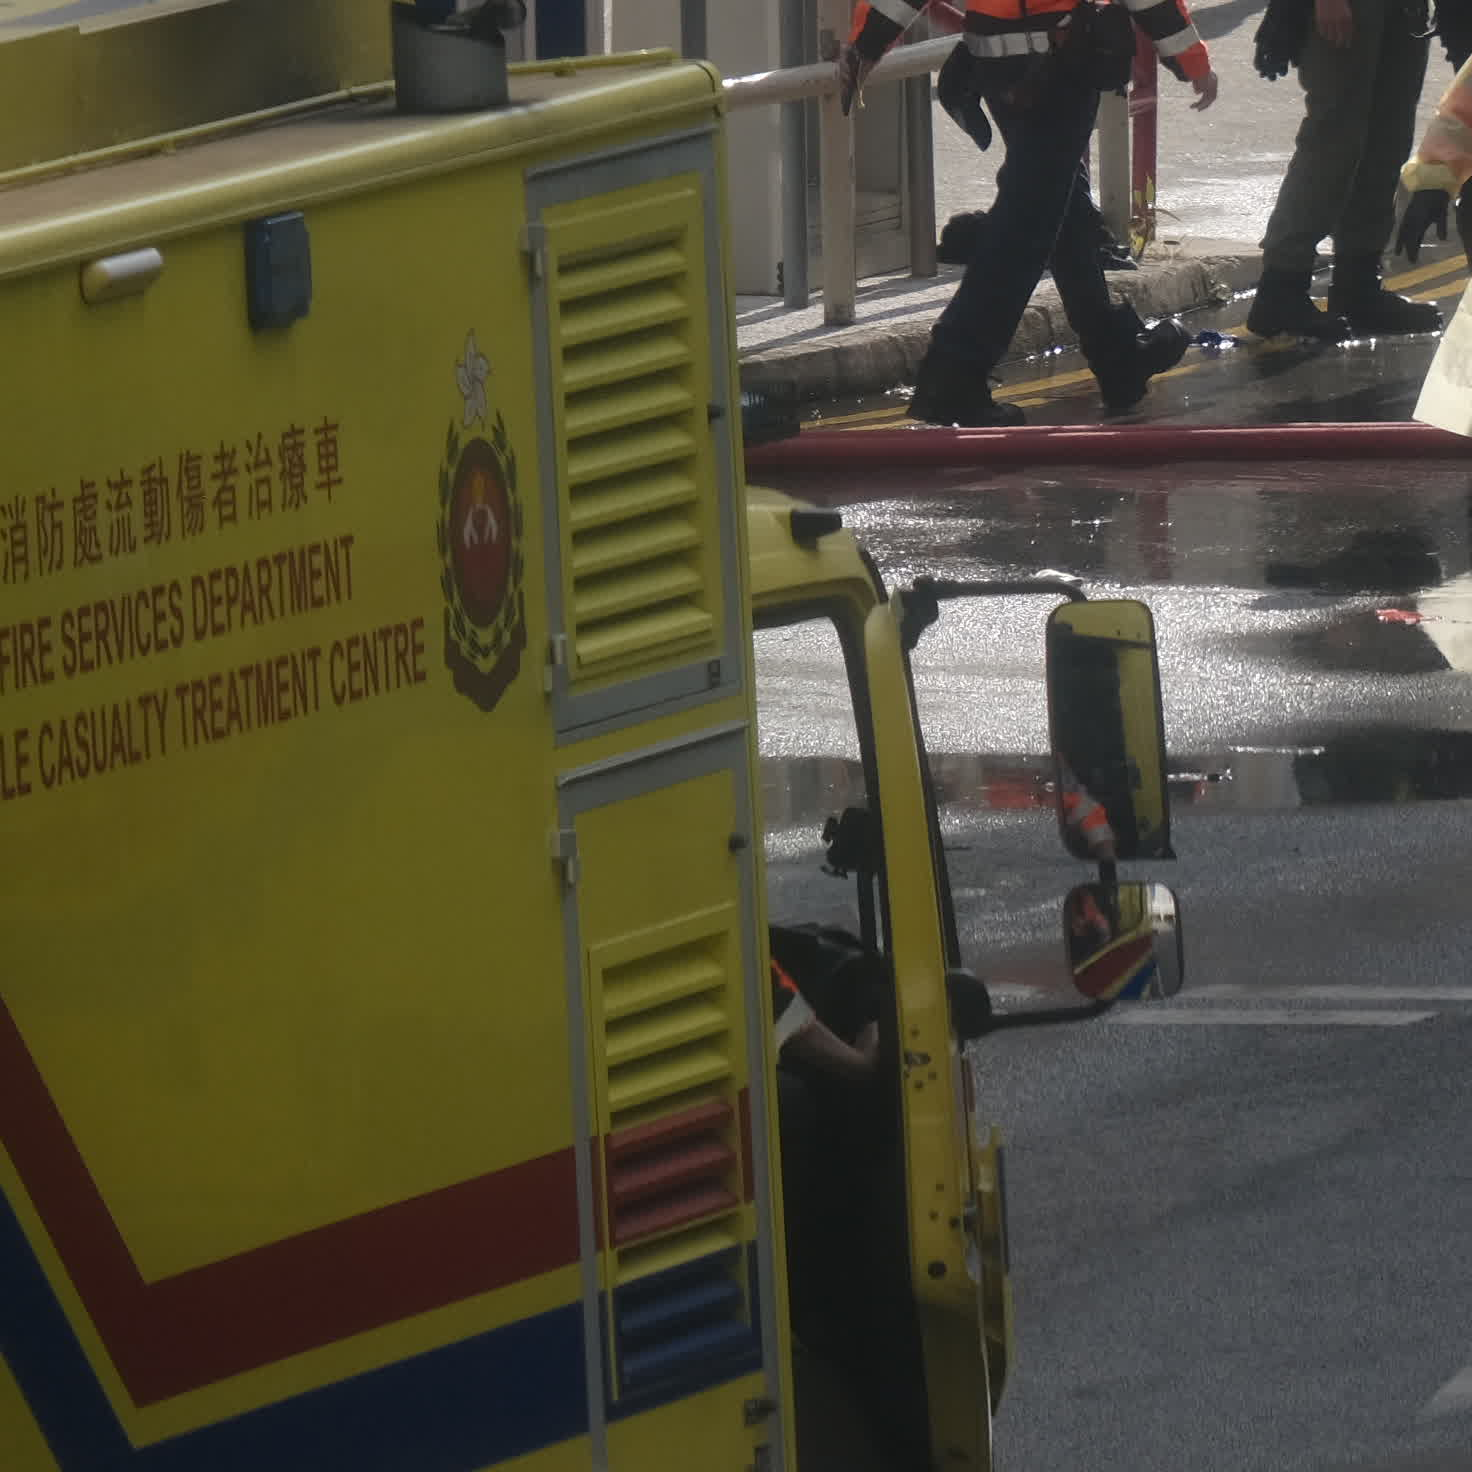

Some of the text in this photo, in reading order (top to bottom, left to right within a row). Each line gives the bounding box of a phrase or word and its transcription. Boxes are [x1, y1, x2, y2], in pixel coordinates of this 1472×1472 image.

[0, 416, 344, 585] 消防處流動傷者治療車
[0, 535, 355, 695] FIRE SERVICES DEPARTMENT
[38, 688, 169, 790] CASUALTY
[176, 646, 322, 750] TREATMENT
[330, 616, 427, 712] CENTRE
